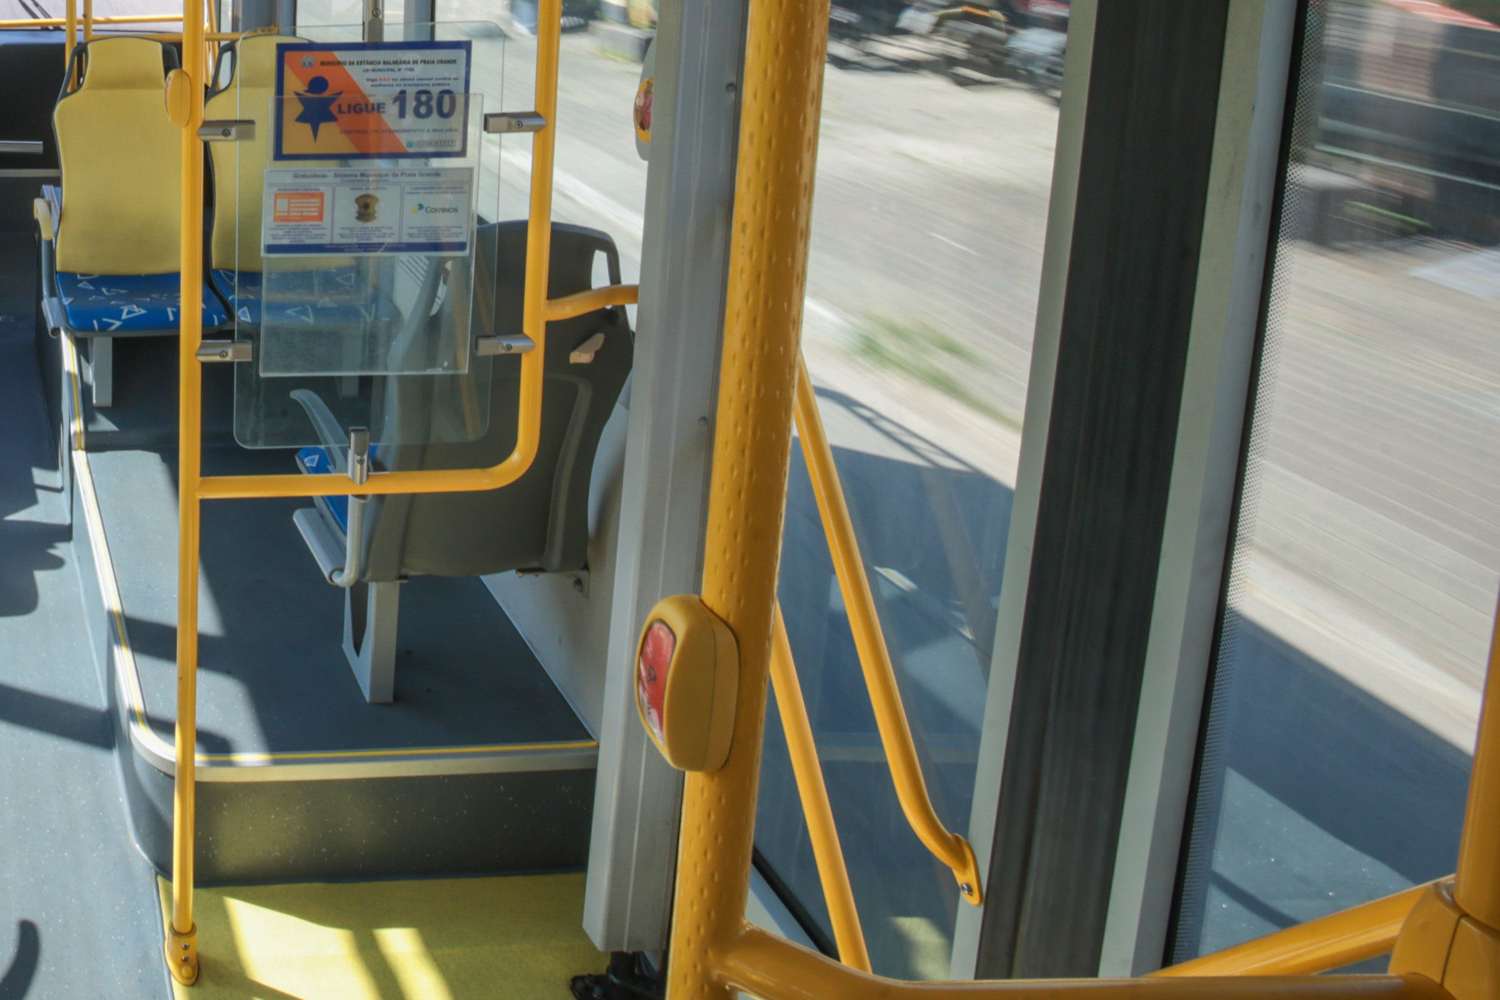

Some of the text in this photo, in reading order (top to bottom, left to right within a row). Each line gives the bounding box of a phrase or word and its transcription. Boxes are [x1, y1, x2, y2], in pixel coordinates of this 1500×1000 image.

[356, 58, 382, 66] ESTÂNCIA
[382, 58, 411, 66] BALNEÁRIA
[337, 89, 457, 119] LIGUE 180
[360, 172, 390, 180] Municipal
[425, 206, 458, 214] Correios
